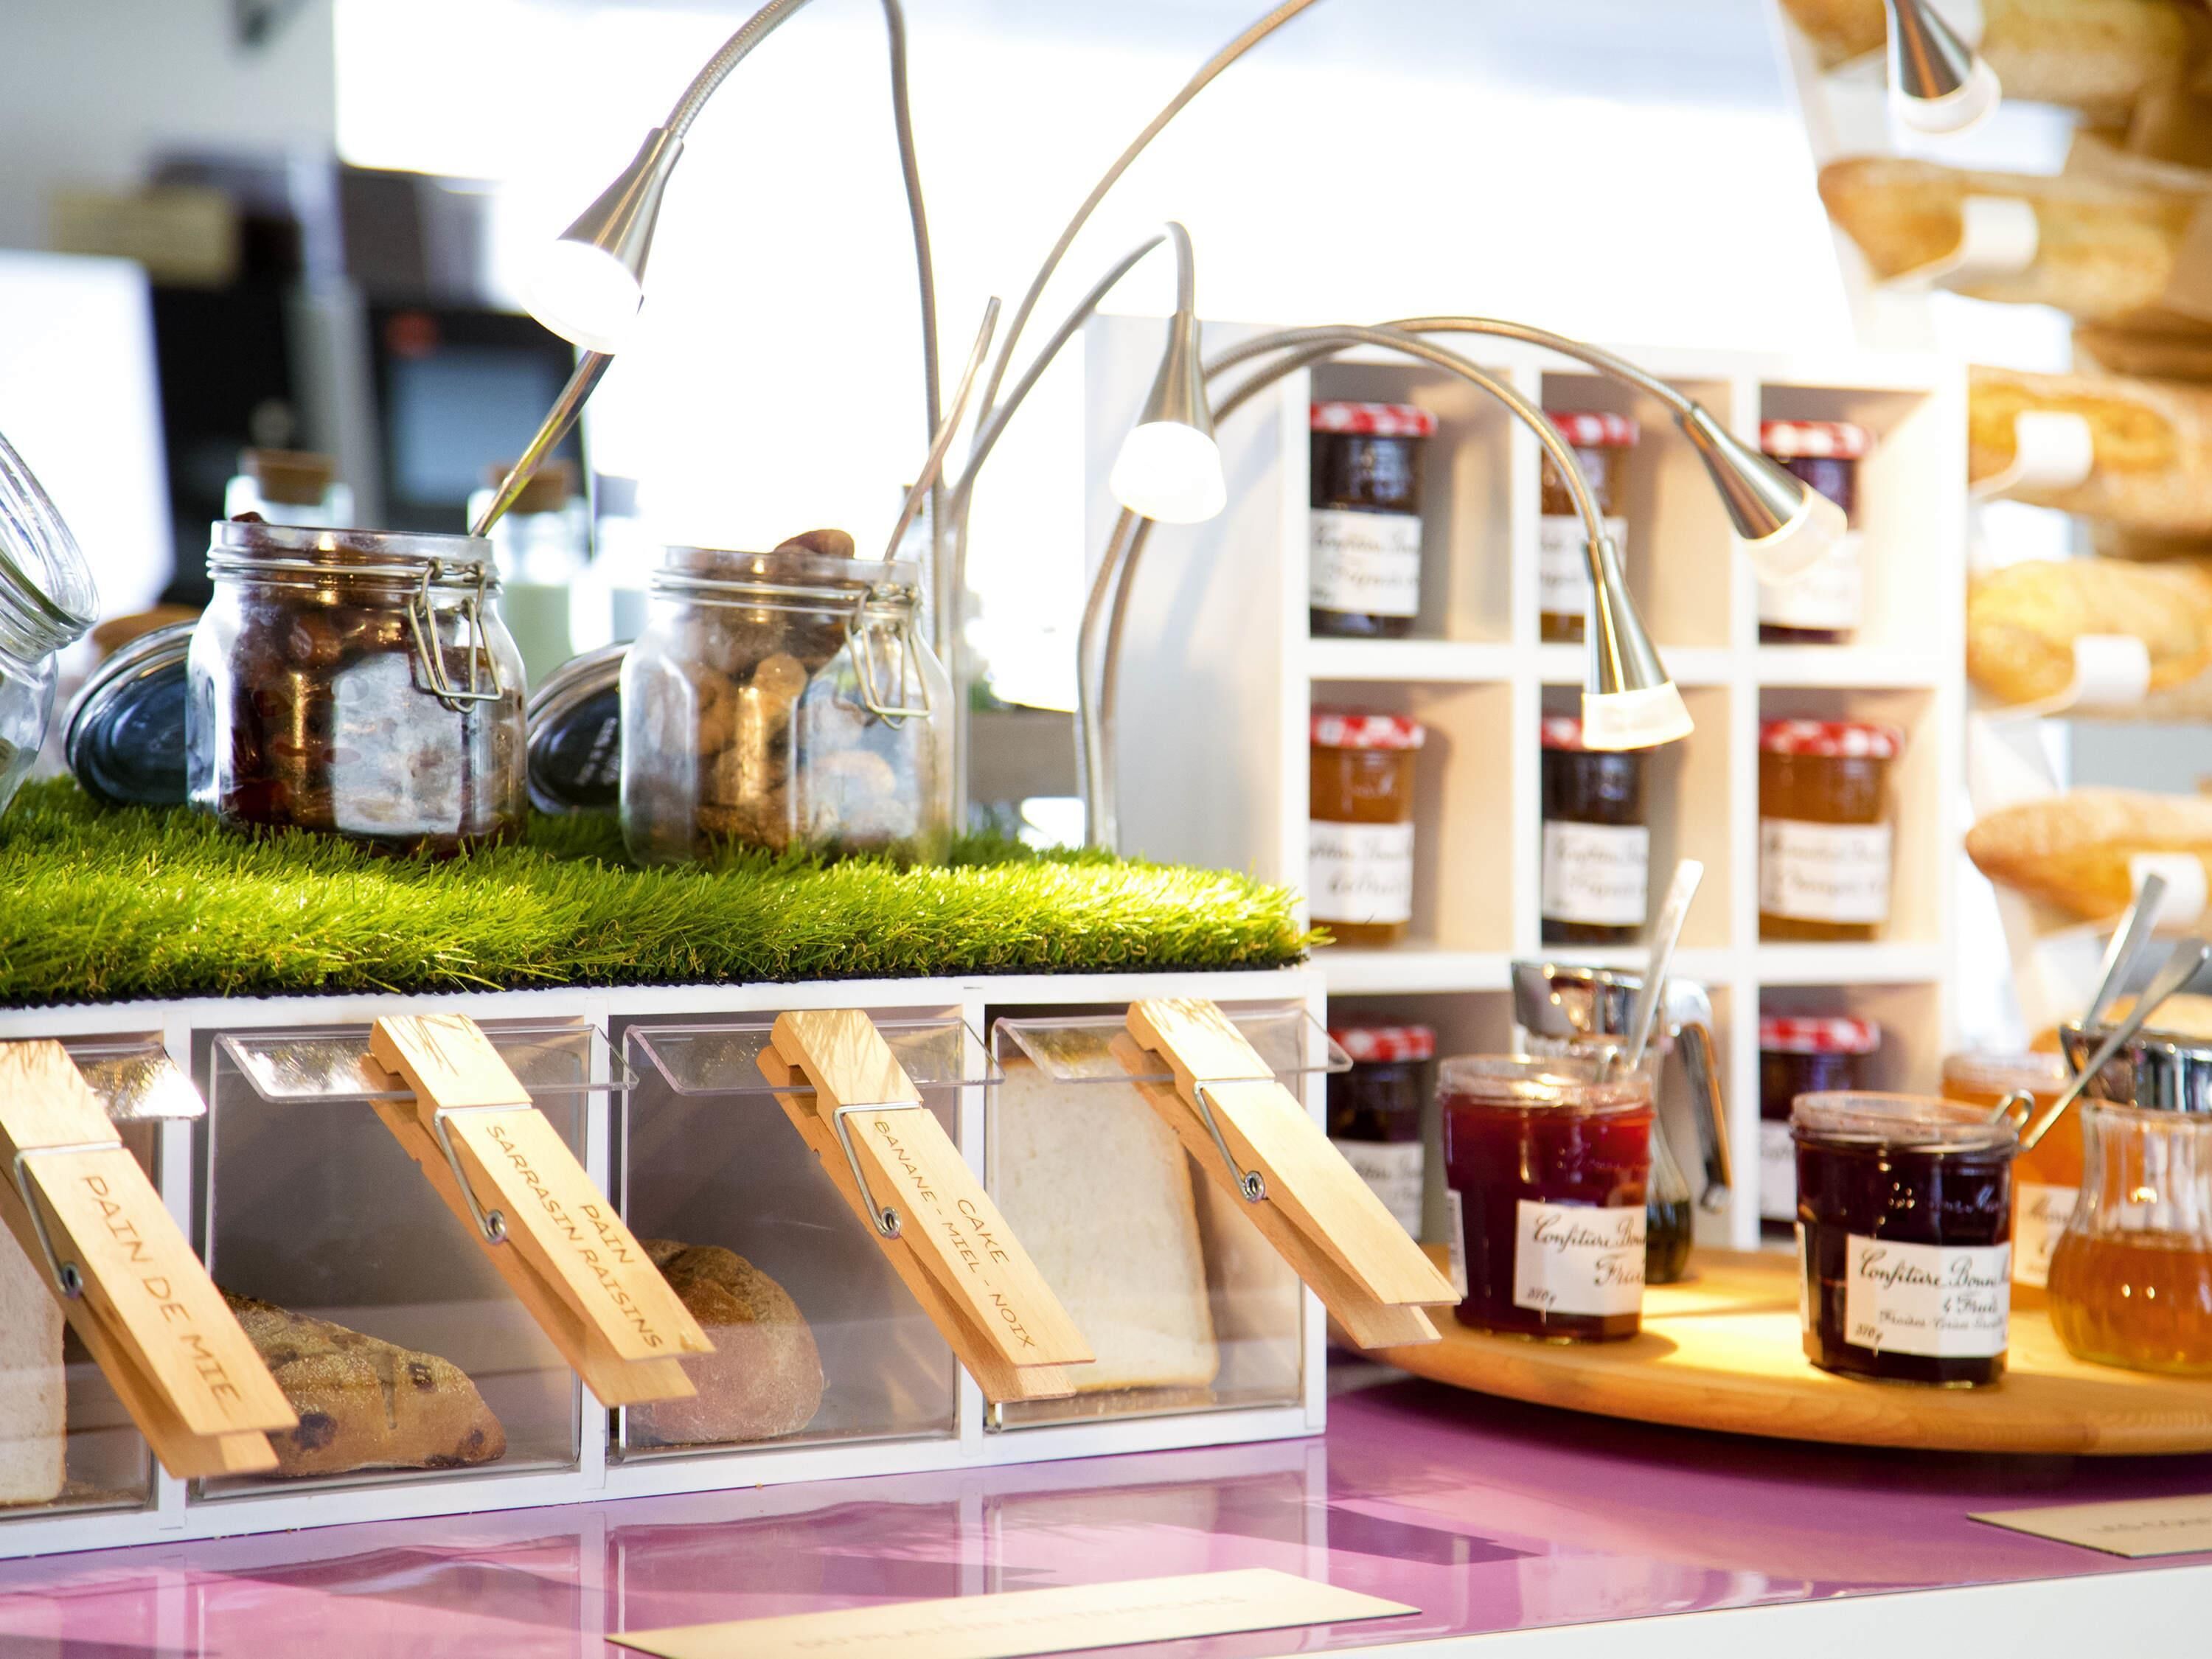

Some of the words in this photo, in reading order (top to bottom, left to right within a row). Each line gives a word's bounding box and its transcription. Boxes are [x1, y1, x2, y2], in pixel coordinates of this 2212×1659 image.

[81, 1175, 153, 1263] PAIN
[142, 1276, 184, 1324] DE
[180, 1333, 240, 1419] MIE
[486, 1124, 585, 1242] SARRASIN
[579, 1248, 664, 1349] RAISINS
[579, 1203, 635, 1265] PAIN
[874, 1120, 938, 1202] BANANE
[940, 1221, 980, 1274] MIEL
[990, 1292, 1036, 1349] NOIX
[957, 1198, 1010, 1264] CAKE
